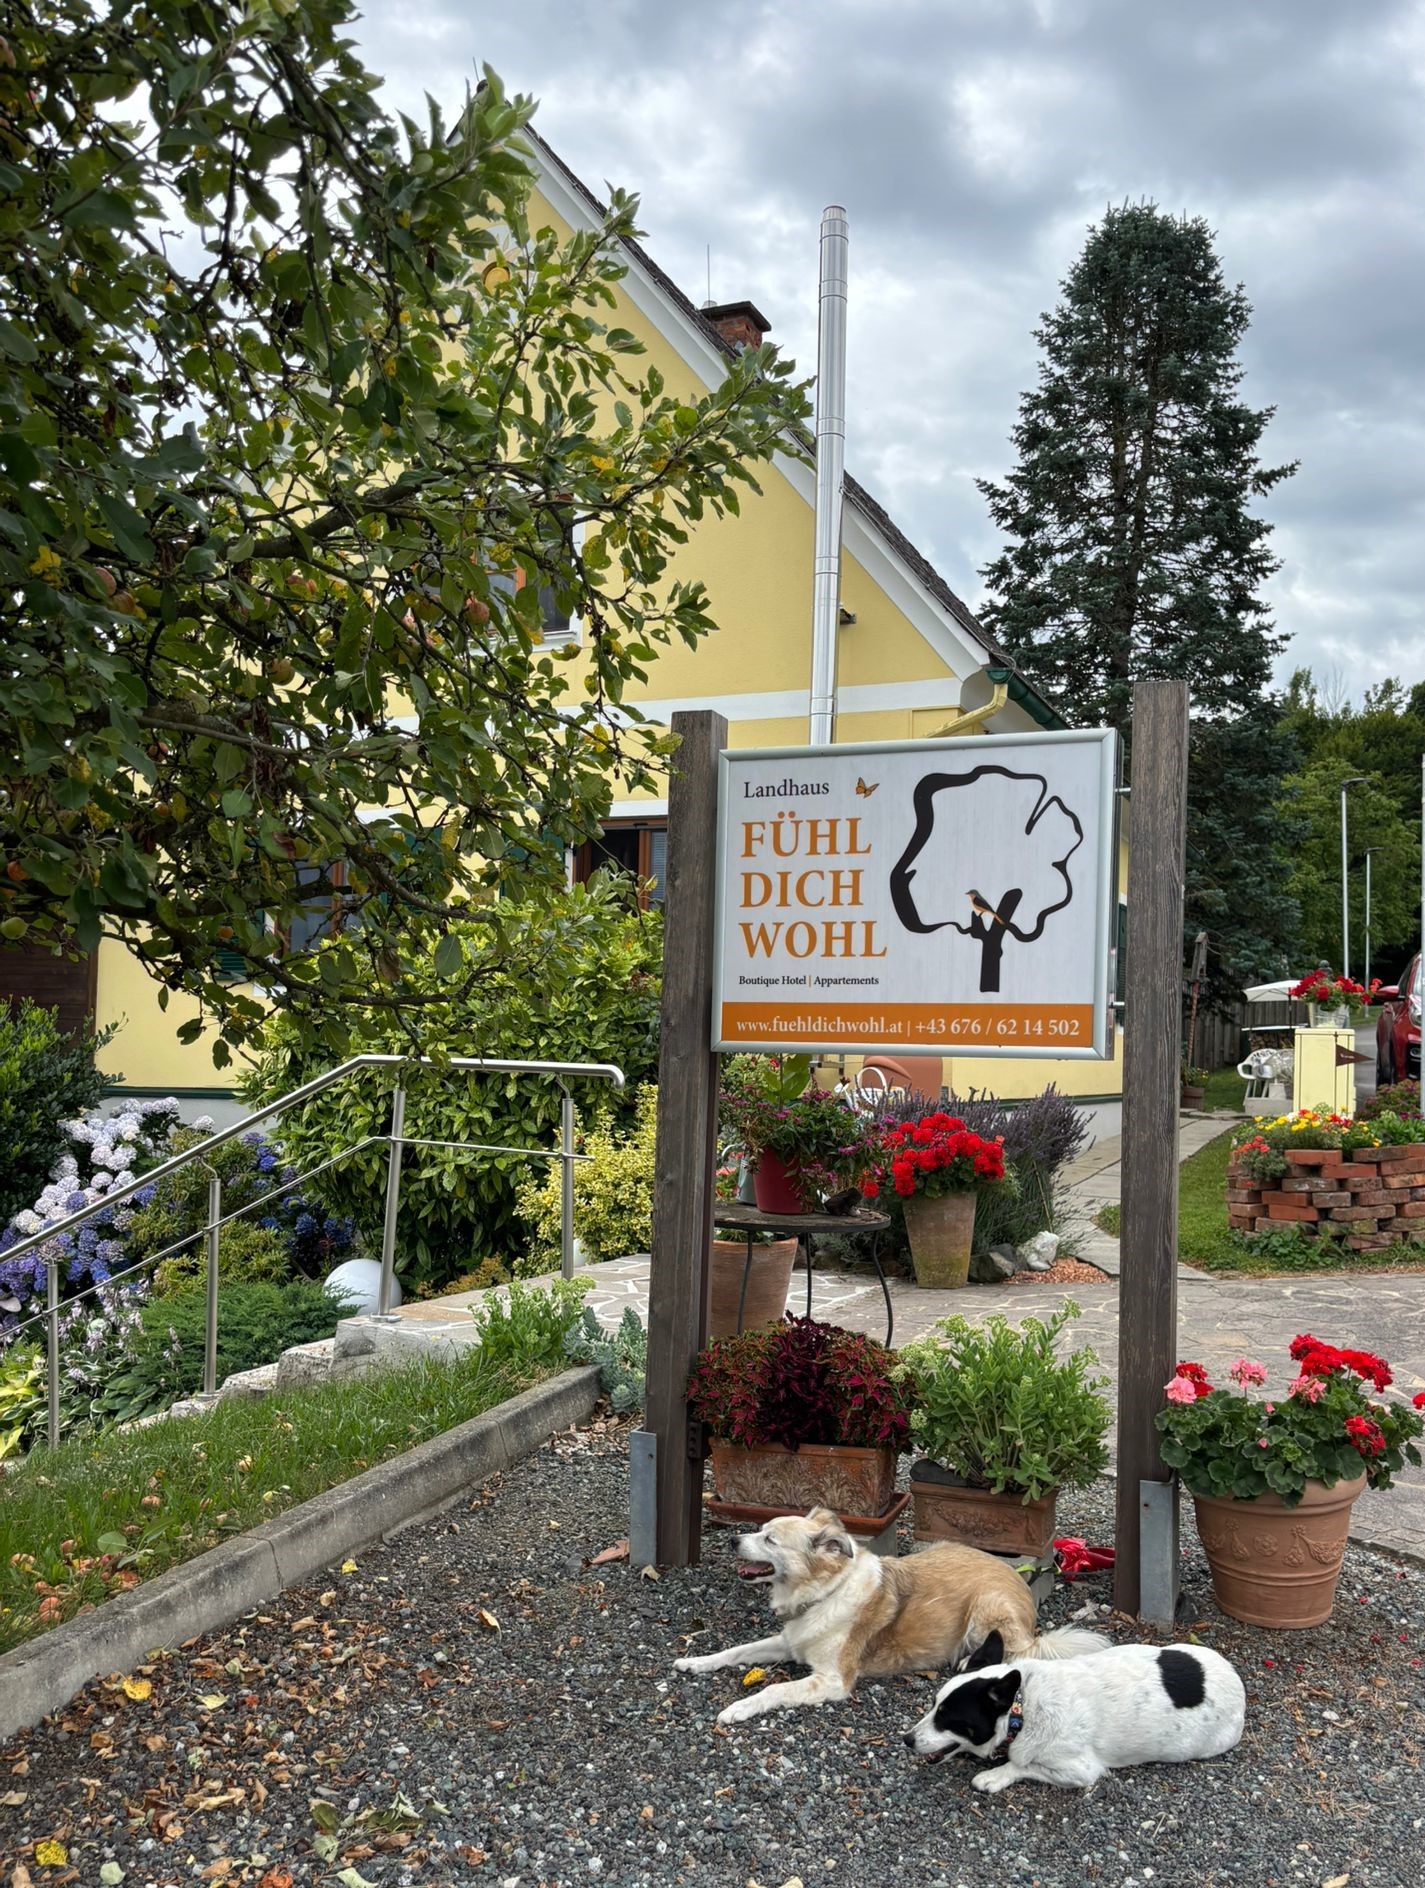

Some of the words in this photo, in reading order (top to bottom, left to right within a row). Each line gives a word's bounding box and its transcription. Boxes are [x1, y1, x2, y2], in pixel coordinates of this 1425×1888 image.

[744, 779, 830, 798] Landhaus
[741, 811, 872, 857] FÜHL
[740, 869, 864, 908] DICH
[738, 920, 887, 958] WOHL
[739, 976, 780, 987] Boutique
[782, 976, 806, 985] Hotel
[814, 976, 879, 987] Appartements
[736, 1016, 902, 1033] www.fuehldichwohl.at
[915, 1018, 946, 1034] +43
[950, 1018, 982, 1034] 676
[996, 1018, 1017, 1035] 62
[1024, 1020, 1043, 1036] 14
[1048, 1020, 1080, 1036] 502
